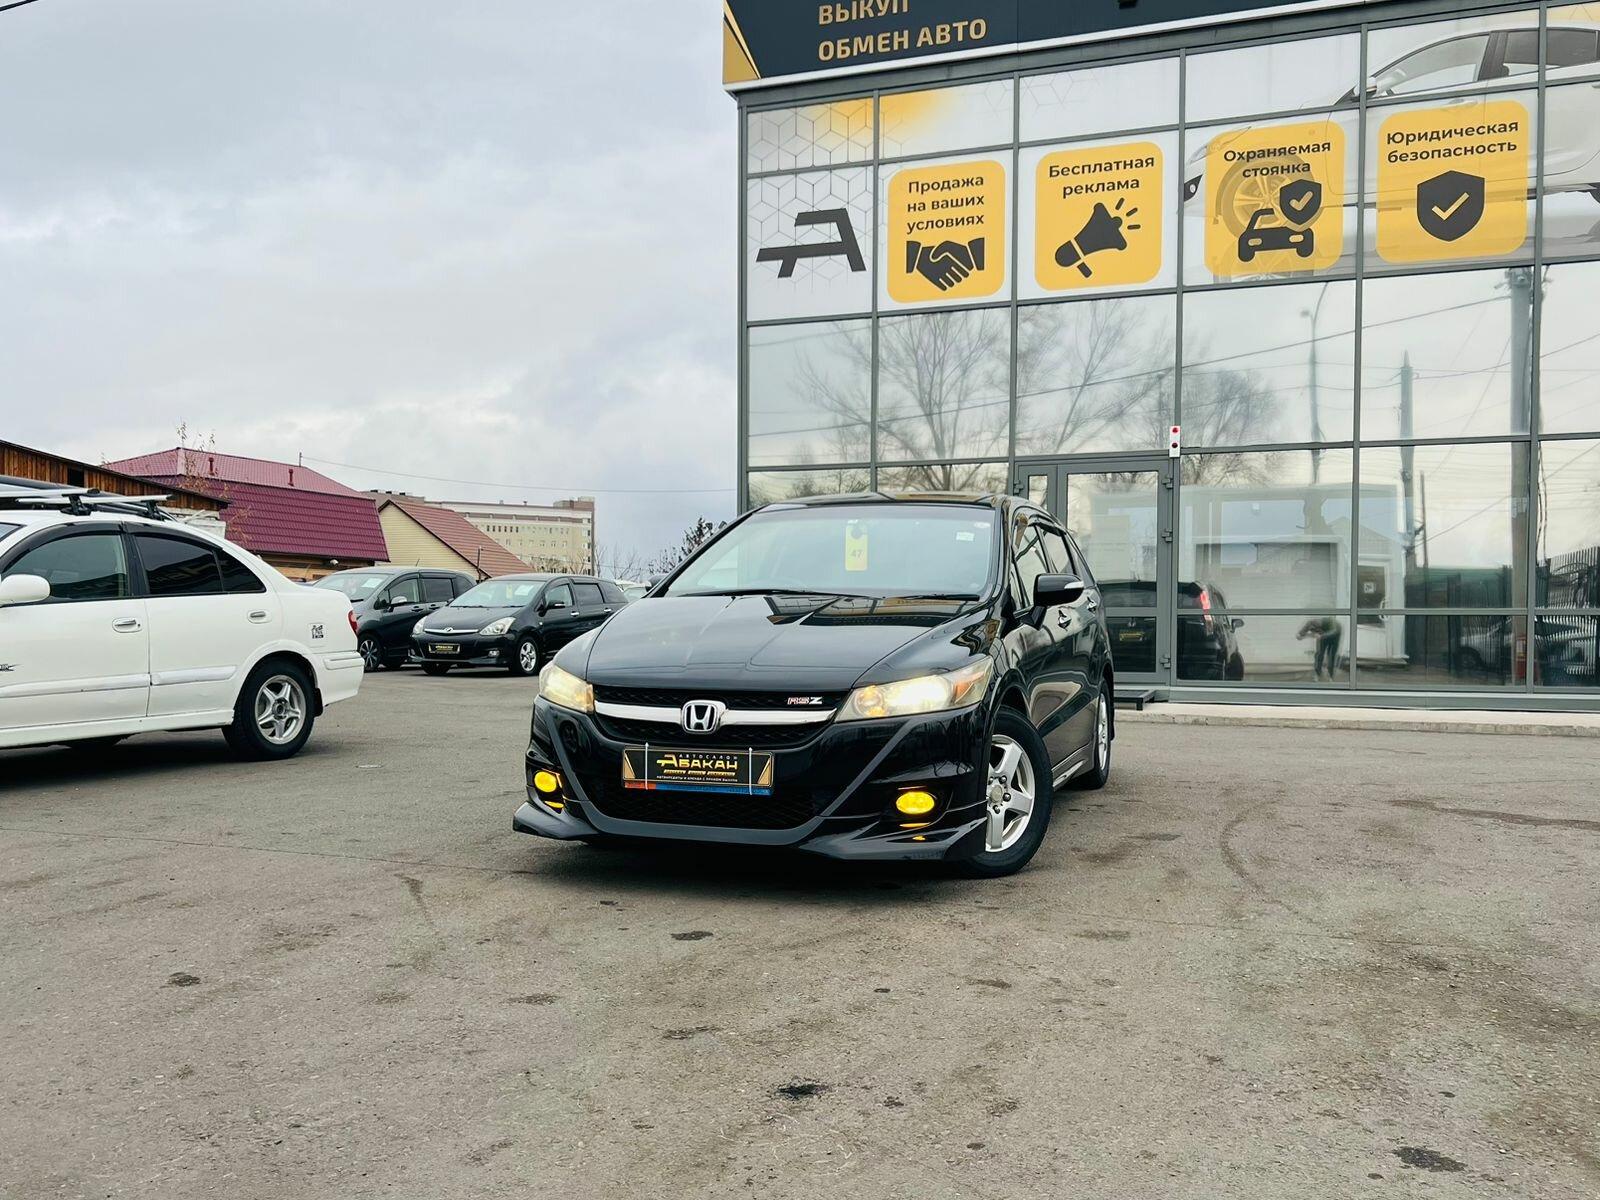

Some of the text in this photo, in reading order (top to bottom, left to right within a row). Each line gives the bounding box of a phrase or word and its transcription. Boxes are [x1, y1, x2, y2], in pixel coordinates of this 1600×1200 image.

[818, 0, 910, 25] ВЫКУП
[818, 18, 987, 61] ОБМЕН АВТО
[1386, 121, 1519, 146] Юридическая
[1223, 142, 1331, 163] Охраняемая
[1387, 139, 1517, 164] безопасность
[1048, 156, 1155, 179] Бесплатная
[1241, 161, 1311, 179] стоянка
[908, 174, 985, 196] Продажа
[1062, 178, 1140, 199] реклама
[907, 195, 985, 213] на ваших
[906, 214, 985, 235] условиях
[656, 754, 738, 770] АБАКАН
